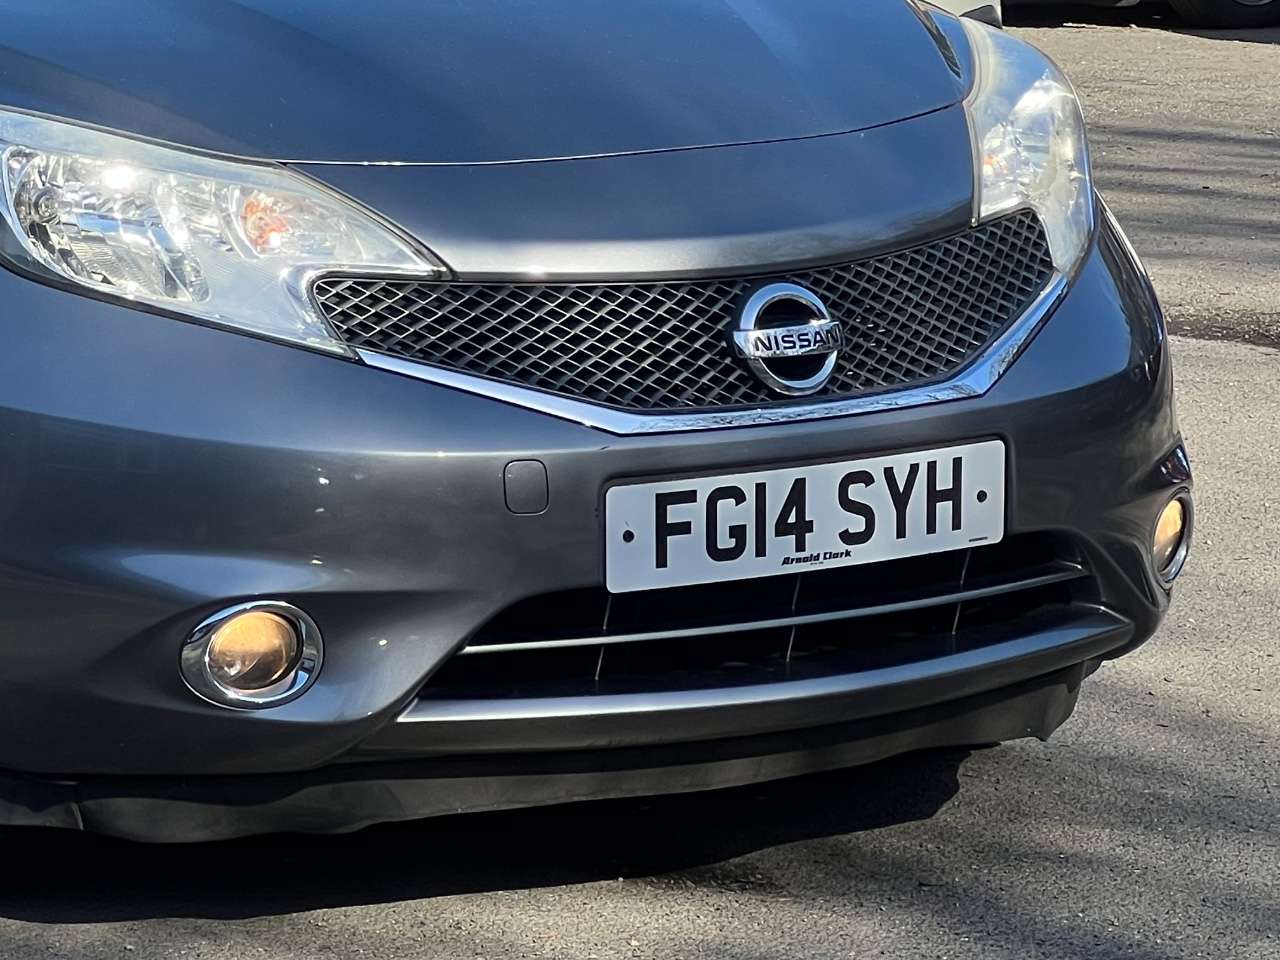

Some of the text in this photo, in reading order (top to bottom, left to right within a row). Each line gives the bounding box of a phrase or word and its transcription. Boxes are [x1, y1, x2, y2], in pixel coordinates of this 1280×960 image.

[754, 324, 841, 352] NISSAN
[654, 456, 963, 569] FG14 SYH
[781, 548, 852, 566] Arnold Clark
